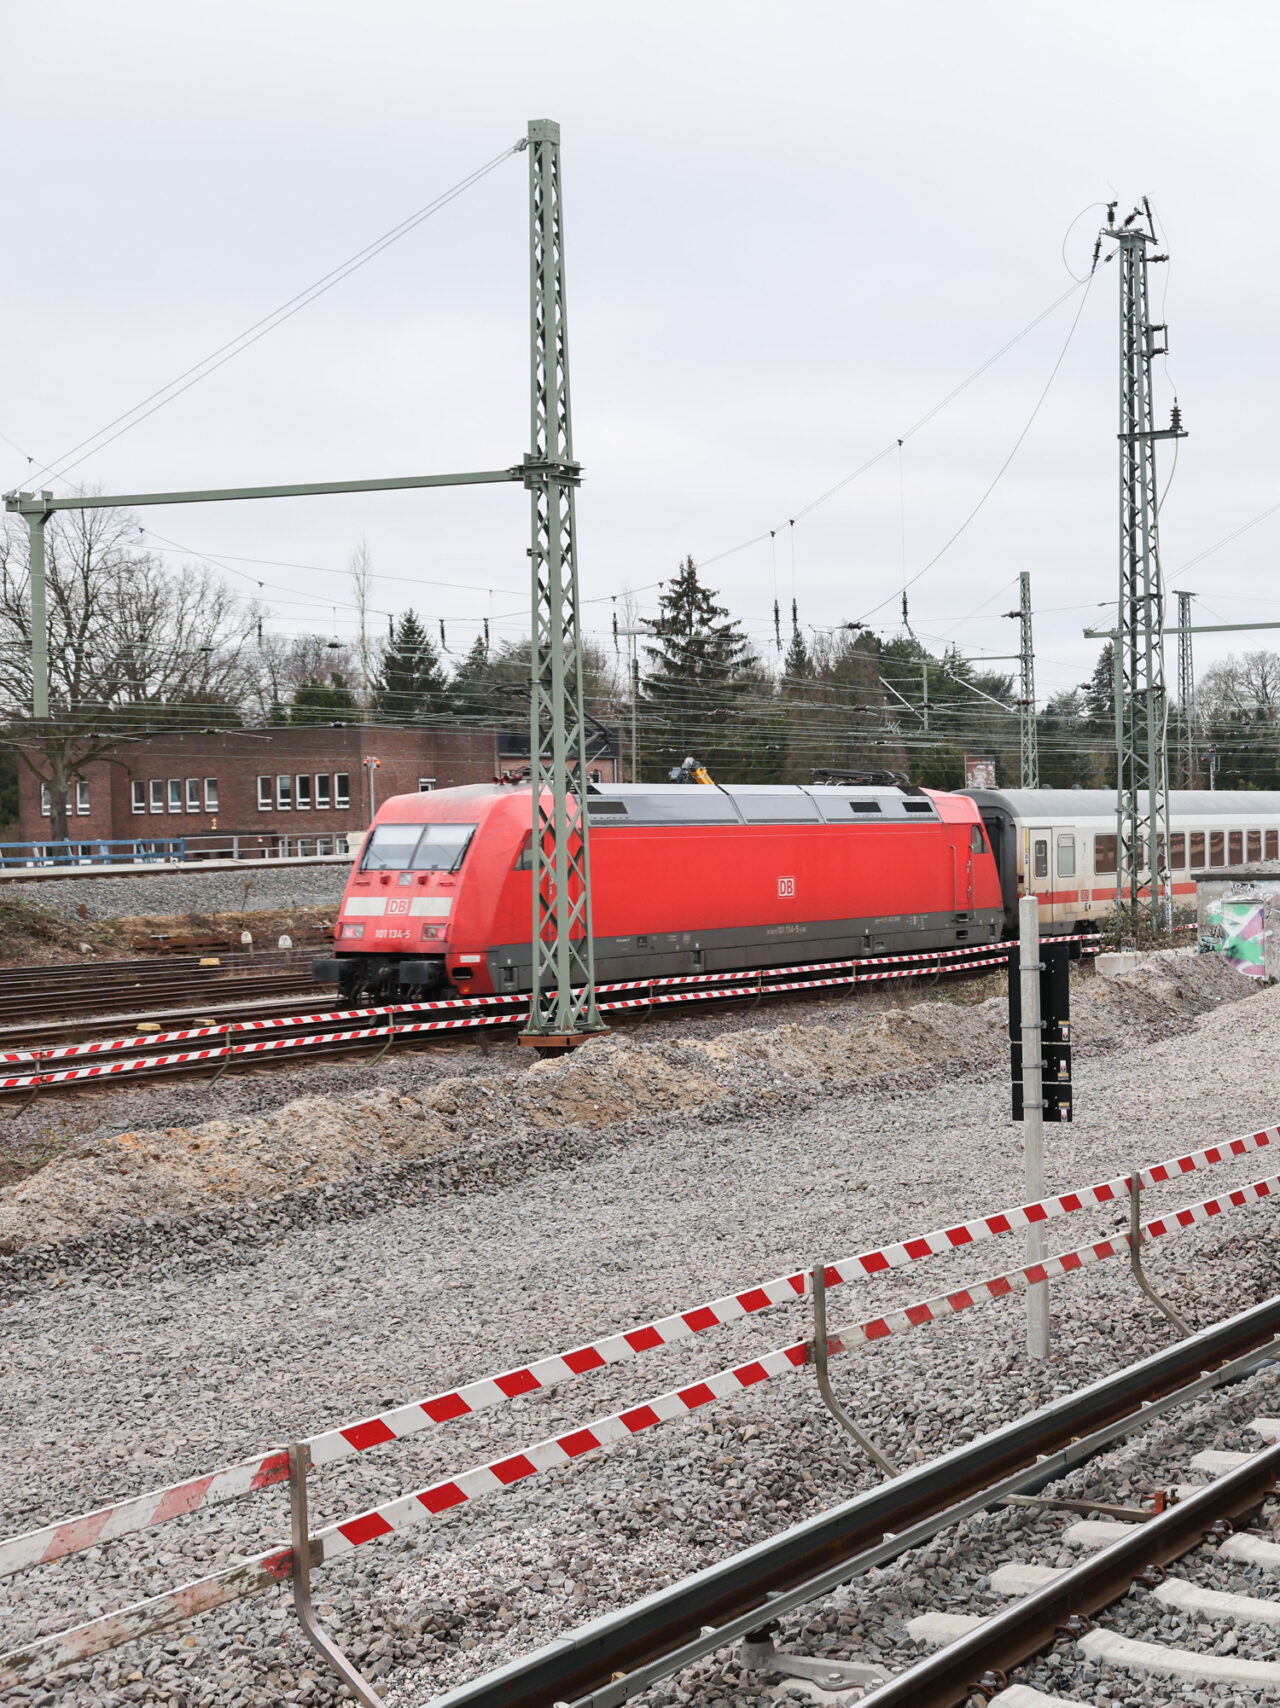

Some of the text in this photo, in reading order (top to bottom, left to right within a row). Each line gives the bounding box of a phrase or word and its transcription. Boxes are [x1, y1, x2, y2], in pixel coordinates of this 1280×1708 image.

[780, 880, 793, 895] DB
[389, 900, 407, 913] DB
[375, 929, 412, 939] 101 134-5
